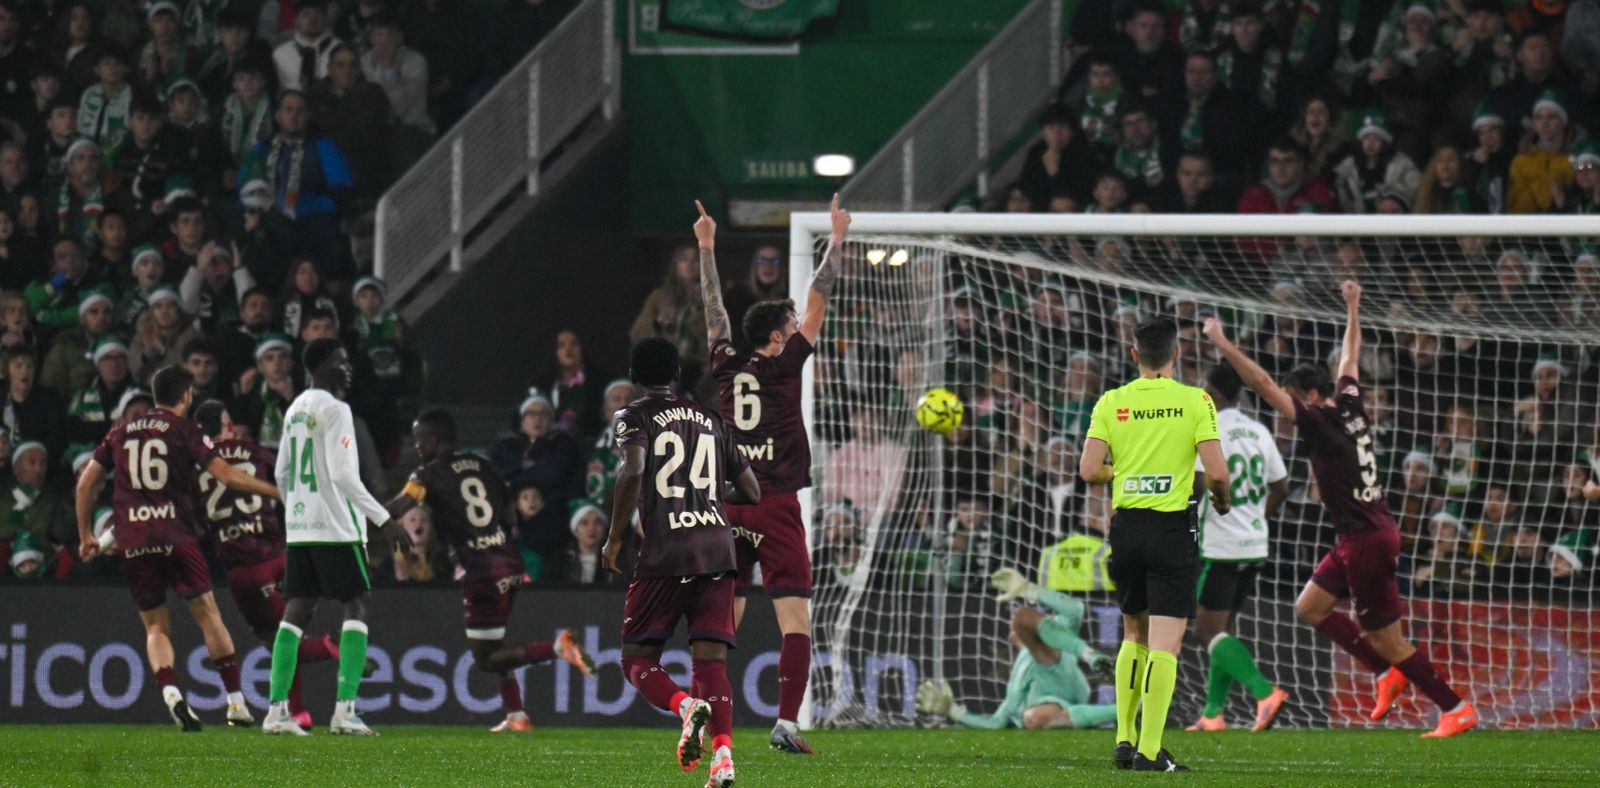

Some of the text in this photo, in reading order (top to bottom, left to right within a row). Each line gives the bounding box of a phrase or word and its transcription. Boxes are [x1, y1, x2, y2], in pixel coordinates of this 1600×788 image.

[126, 419, 171, 433] MELERO
[653, 407, 714, 431] DIAWARA
[733, 372, 761, 431] 6
[1133, 407, 1184, 420] WÜRTH
[123, 438, 169, 490] 16
[288, 437, 318, 493] 14
[654, 431, 718, 501] 24
[1124, 476, 1172, 495] BKT
[1227, 453, 1266, 506] 29
[1356, 434, 1378, 487] 5
[460, 477, 494, 528] 8
[742, 651, 917, 719] con
